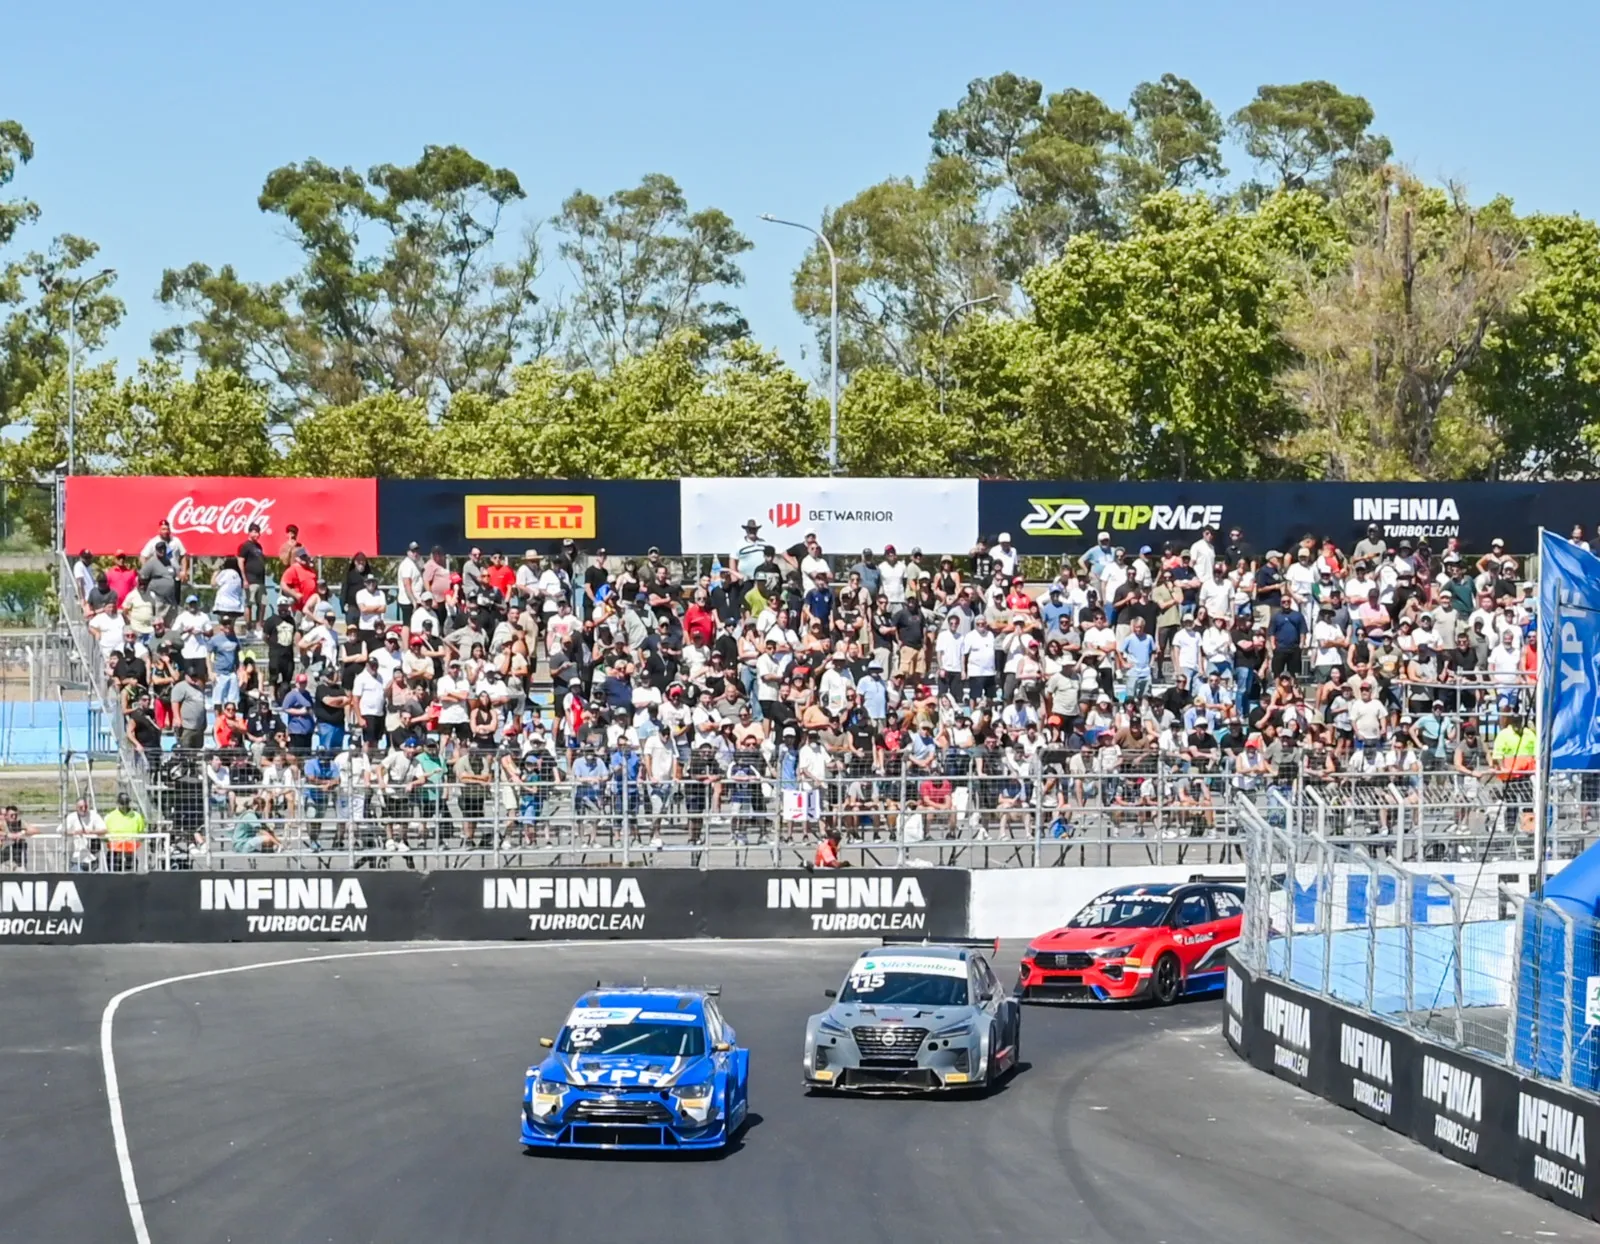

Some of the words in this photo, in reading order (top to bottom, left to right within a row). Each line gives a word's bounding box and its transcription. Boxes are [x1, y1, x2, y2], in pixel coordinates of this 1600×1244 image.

[167, 497, 276, 534] Coca-Cola
[477, 505, 583, 528] PIRELLI
[809, 510, 893, 521] BETWARRIOR
[1353, 498, 1459, 520] INFINIA
[1383, 525, 1459, 537] TURBOCLEAN
[0, 881, 84, 913] NIA
[200, 877, 367, 911] INFINIA
[482, 877, 646, 910] INFINIA
[767, 876, 927, 910] INFINIA
[247, 915, 368, 933] TURBOCLEAN
[529, 913, 646, 932] TURBOCLEAN
[810, 912, 926, 932] TURBOCLEAN
[849, 975, 886, 989] 115
[570, 1027, 602, 1042] 64
[1263, 992, 1311, 1050] INFINIA
[1340, 1023, 1393, 1085] INFINIA
[1422, 1055, 1482, 1122] INFINIA
[1434, 1114, 1479, 1154] TURBOCLEAN
[1518, 1092, 1587, 1165] INFINIA
[1534, 1155, 1584, 1199] TURBOCLEAN
